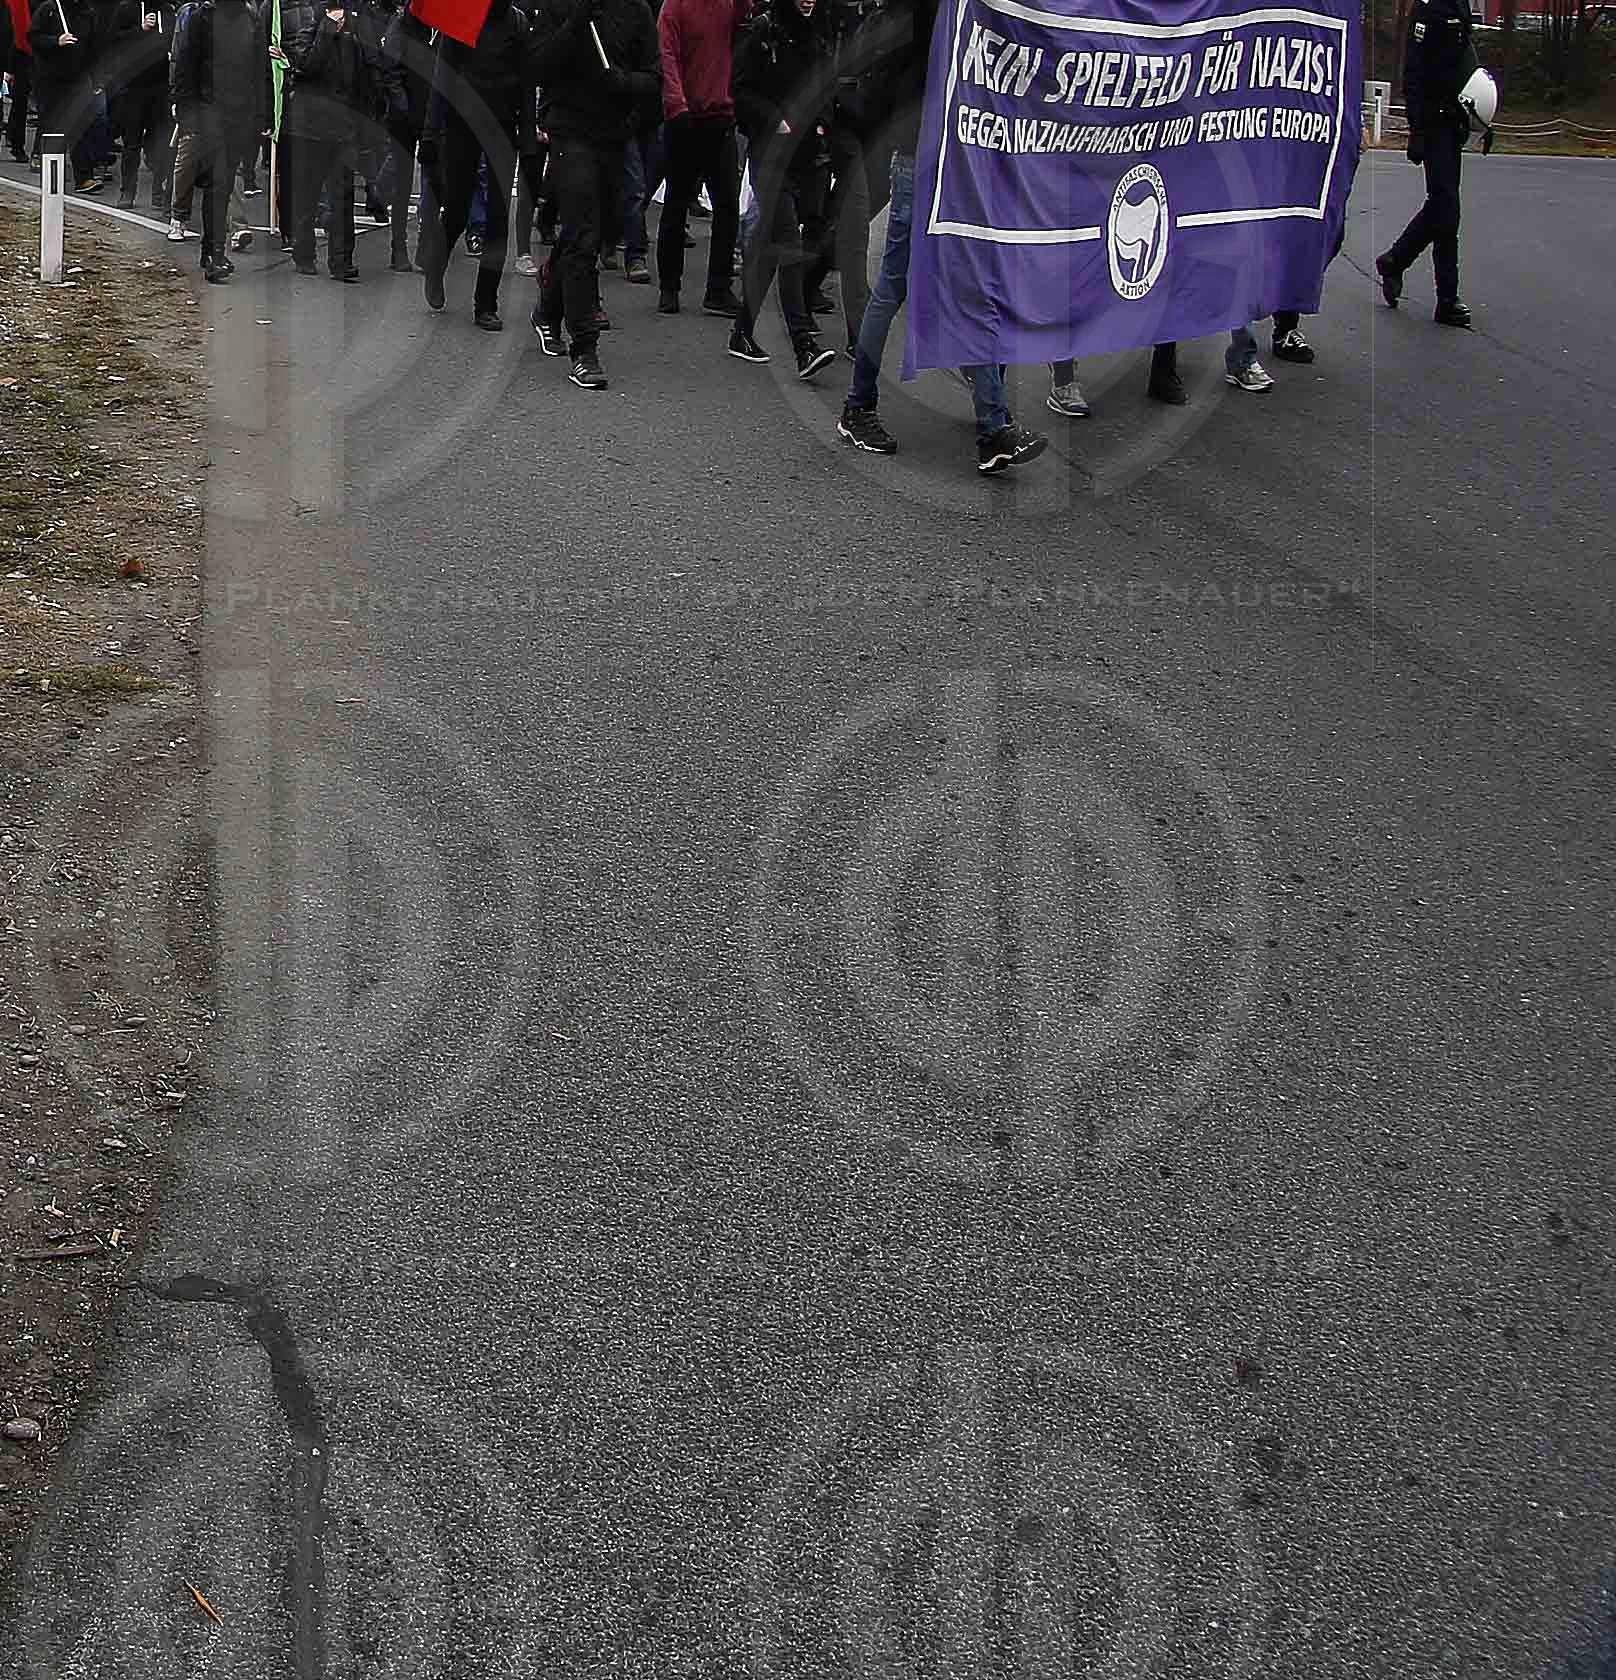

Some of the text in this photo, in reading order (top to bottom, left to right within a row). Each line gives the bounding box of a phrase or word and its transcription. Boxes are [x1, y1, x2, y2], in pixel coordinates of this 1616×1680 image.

[962, 21, 1335, 108] KEIN SPIELFELD FÜR NAZIS!
[957, 104, 1331, 155] GEGEN NAZIAUFMARSCH UND FESTUNG EUROPA
